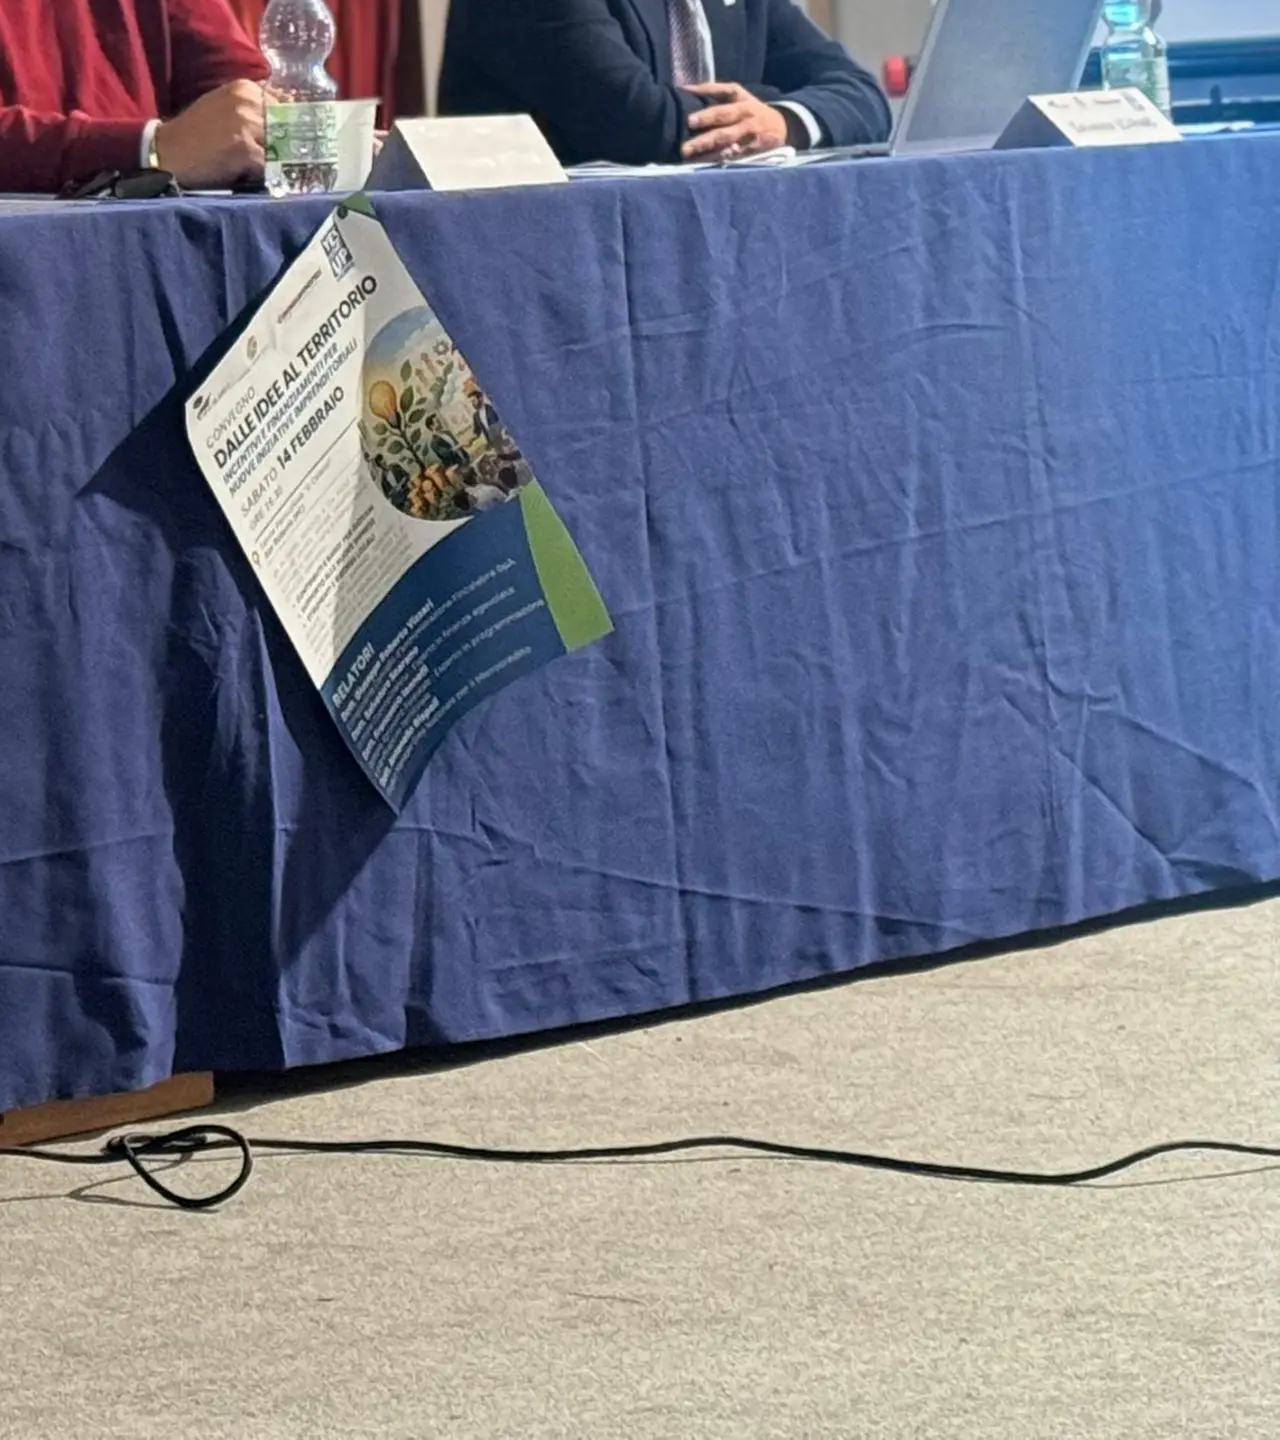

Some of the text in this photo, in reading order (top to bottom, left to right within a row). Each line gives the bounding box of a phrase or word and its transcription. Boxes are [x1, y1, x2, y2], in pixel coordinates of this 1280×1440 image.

[204, 384, 257, 449] CONVEGNO
[212, 411, 260, 470] DALLE
[251, 378, 287, 422] IDEE
[283, 363, 301, 389] AL
[296, 271, 380, 367] TERRITORIO
[221, 432, 264, 485] INCENTIVI
[264, 359, 326, 433] FINANZIAMENTI
[321, 342, 340, 365] PER
[228, 458, 258, 497] NUOVE
[239, 465, 280, 518] SABATO
[274, 449, 293, 470] 14
[287, 384, 347, 455] FEBBRAIO
[331, 640, 377, 709] RELATORI
